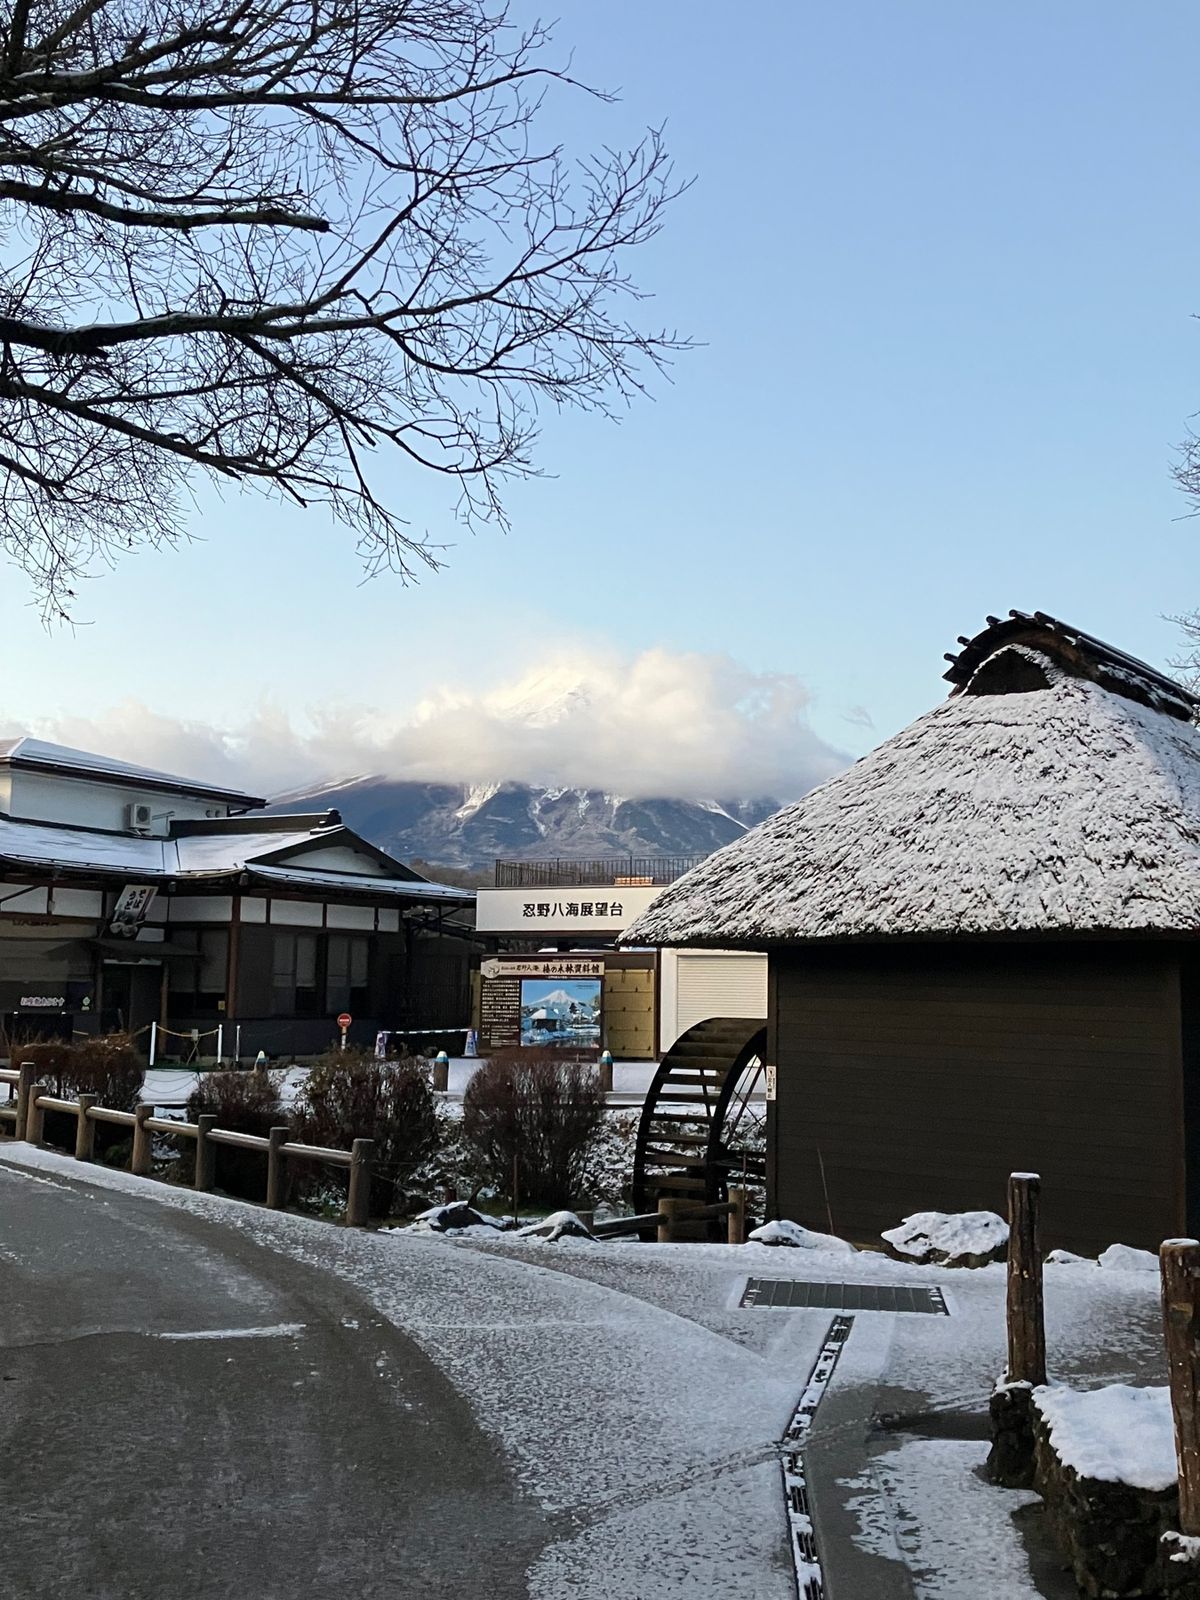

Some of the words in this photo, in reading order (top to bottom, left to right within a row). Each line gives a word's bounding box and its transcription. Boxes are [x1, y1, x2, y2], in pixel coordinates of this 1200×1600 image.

[522, 902, 624, 918] 忍野八海展望台
